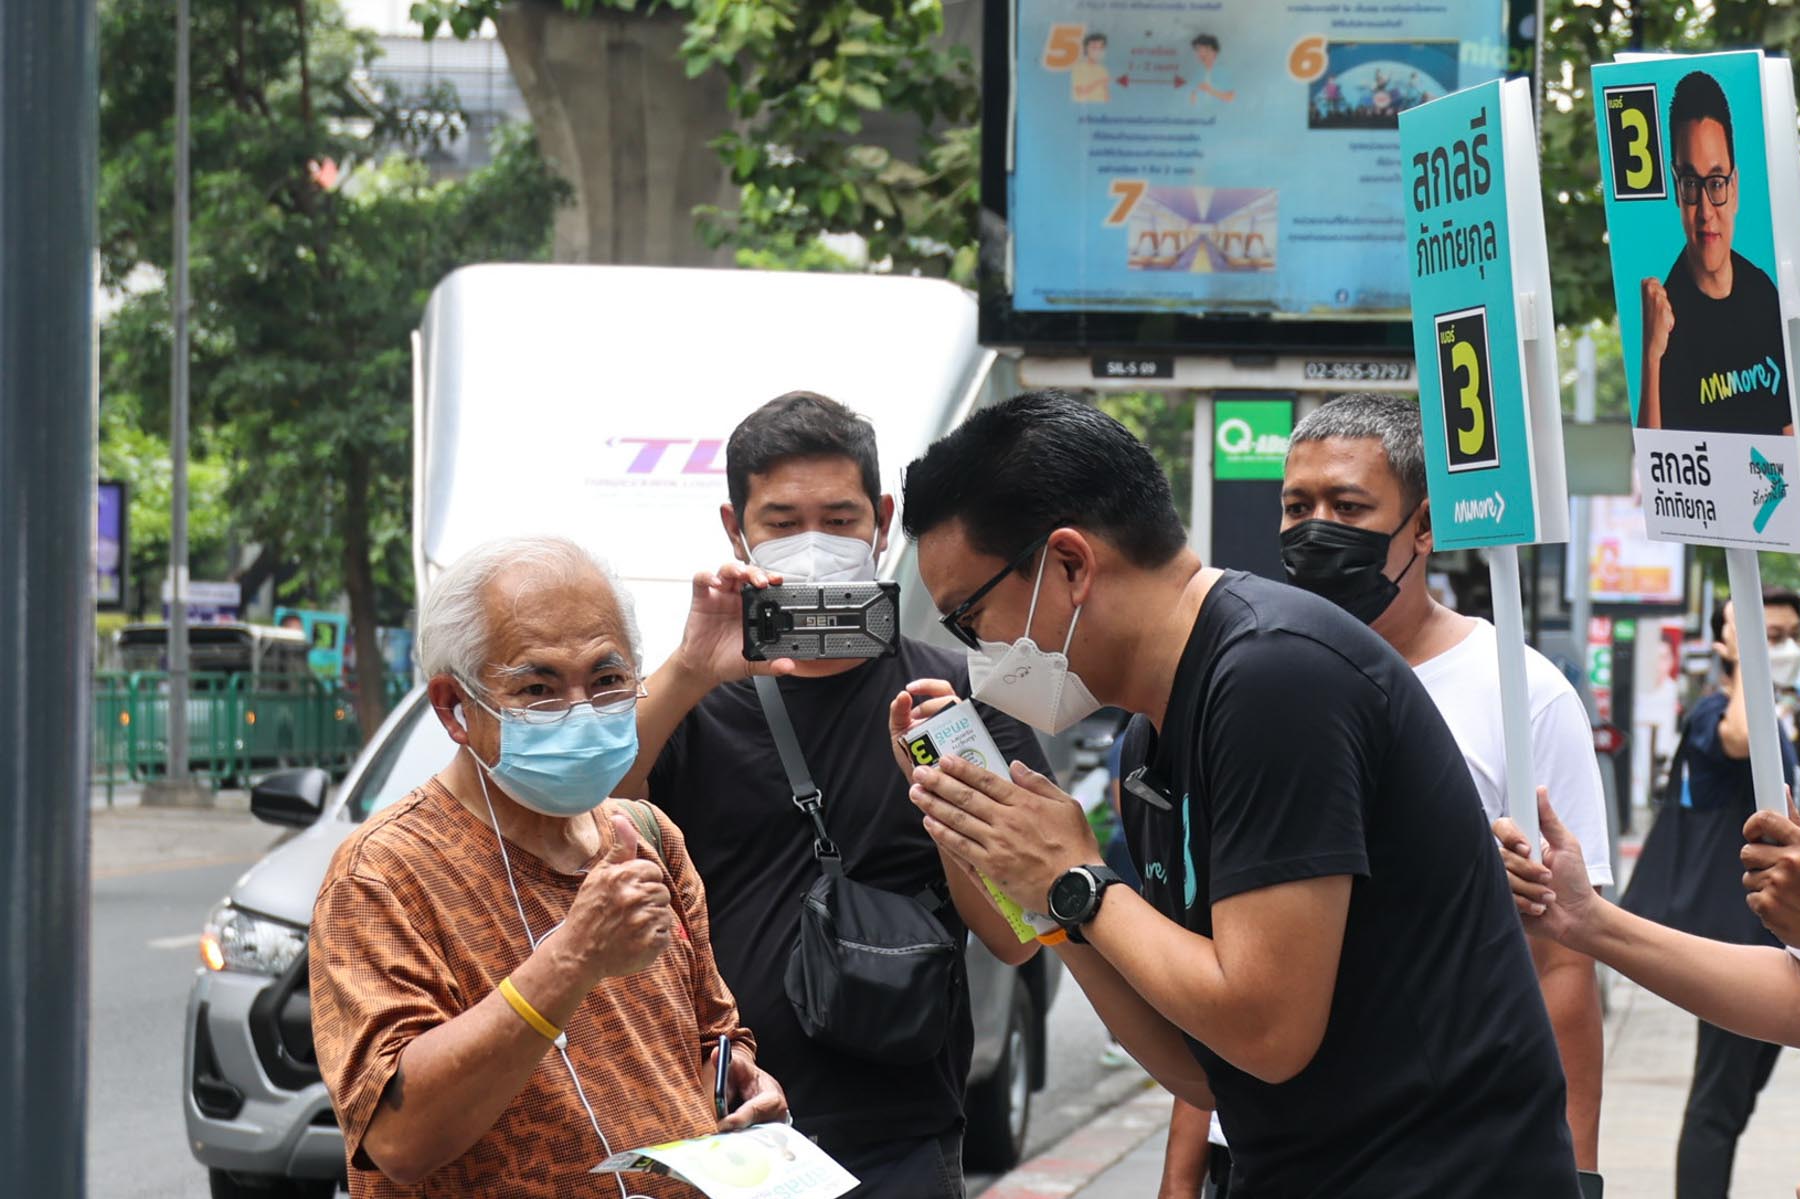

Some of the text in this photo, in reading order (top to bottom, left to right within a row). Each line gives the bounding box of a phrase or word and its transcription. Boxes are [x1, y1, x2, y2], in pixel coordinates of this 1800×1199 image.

[1043, 24, 1084, 70] 5
[1288, 37, 1326, 81] 6
[1413, 106, 1491, 213] สกลธี
[1620, 107, 1653, 190] 3
[1106, 181, 1145, 226] 7
[1417, 220, 1497, 280] ภัททิยกุล
[1451, 341, 1485, 456] 3
[1650, 441, 1711, 487] สกลธี
[1654, 489, 1716, 529] ภัททิยกุล
[911, 739, 933, 765] 3
